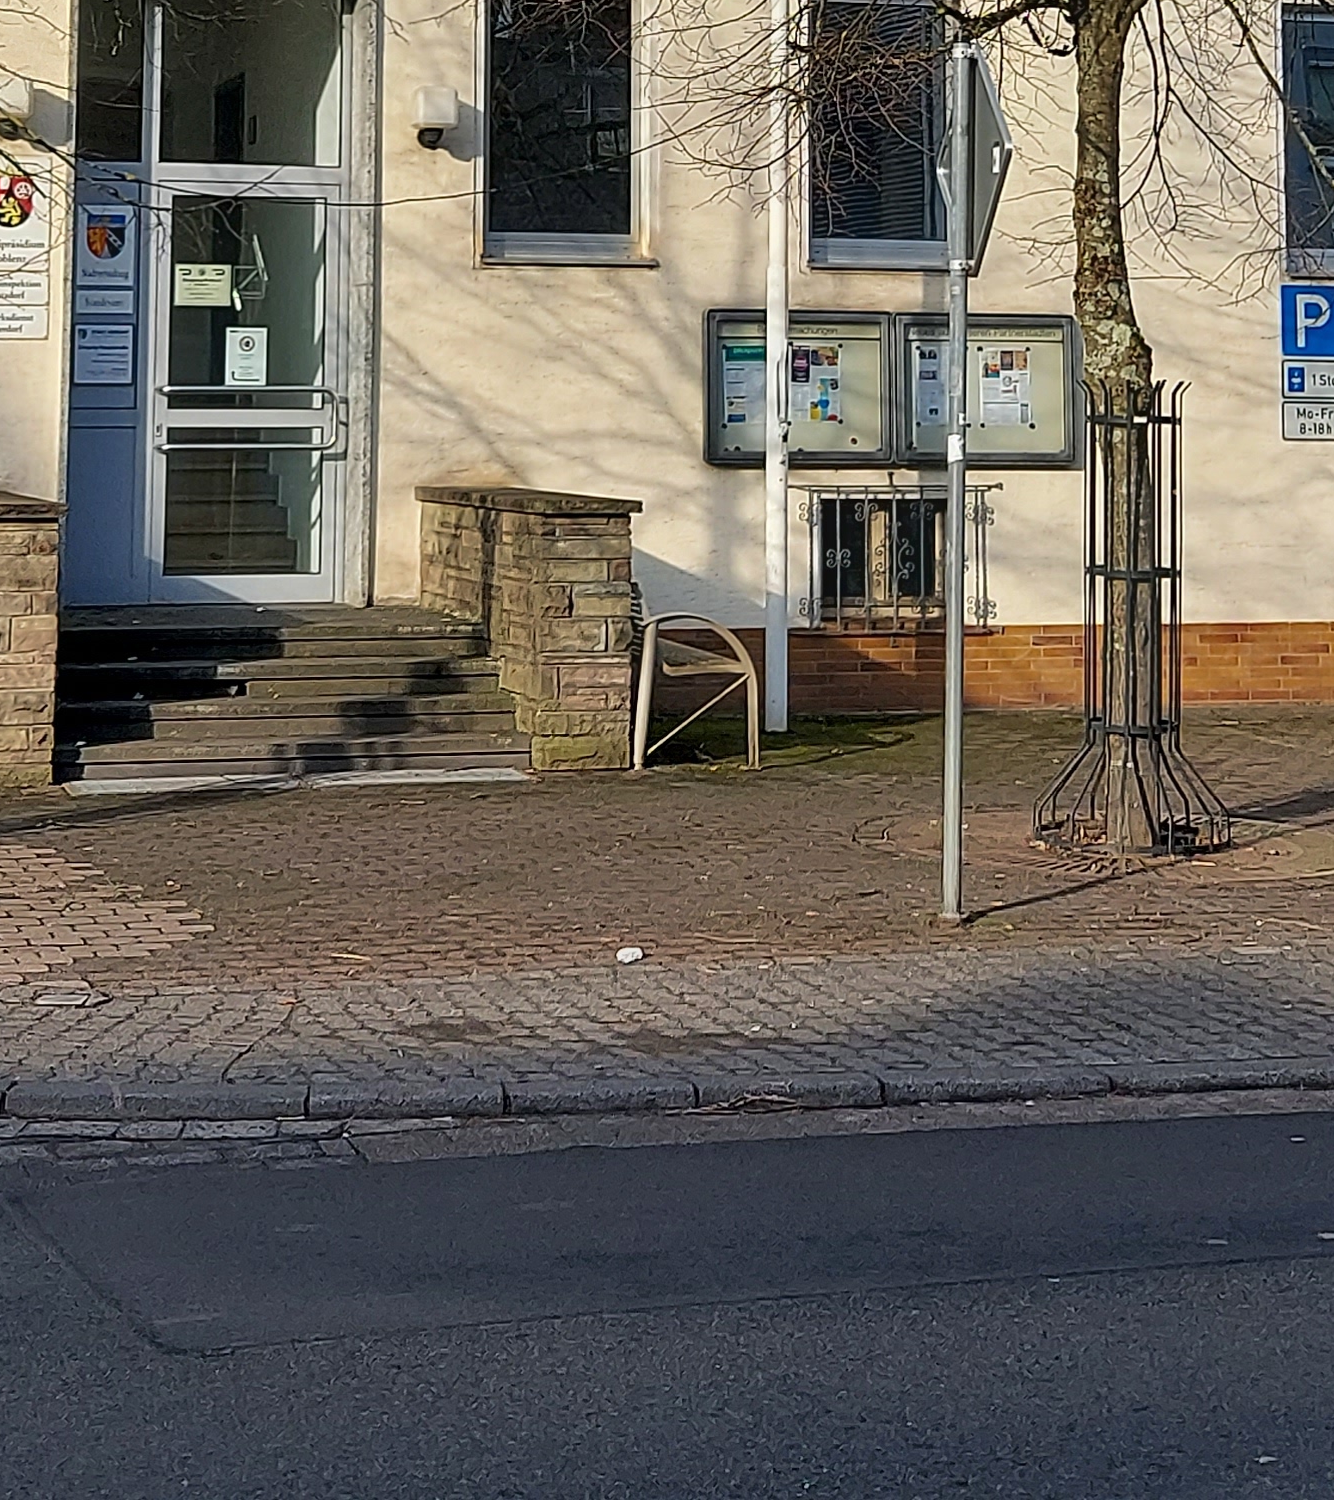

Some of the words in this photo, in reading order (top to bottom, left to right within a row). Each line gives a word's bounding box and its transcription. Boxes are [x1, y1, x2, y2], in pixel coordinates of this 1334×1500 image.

[1295, 293, 1332, 348] P
[1312, 373, 1316, 387] 1
[1296, 407, 1334, 420] Mo-Fr
